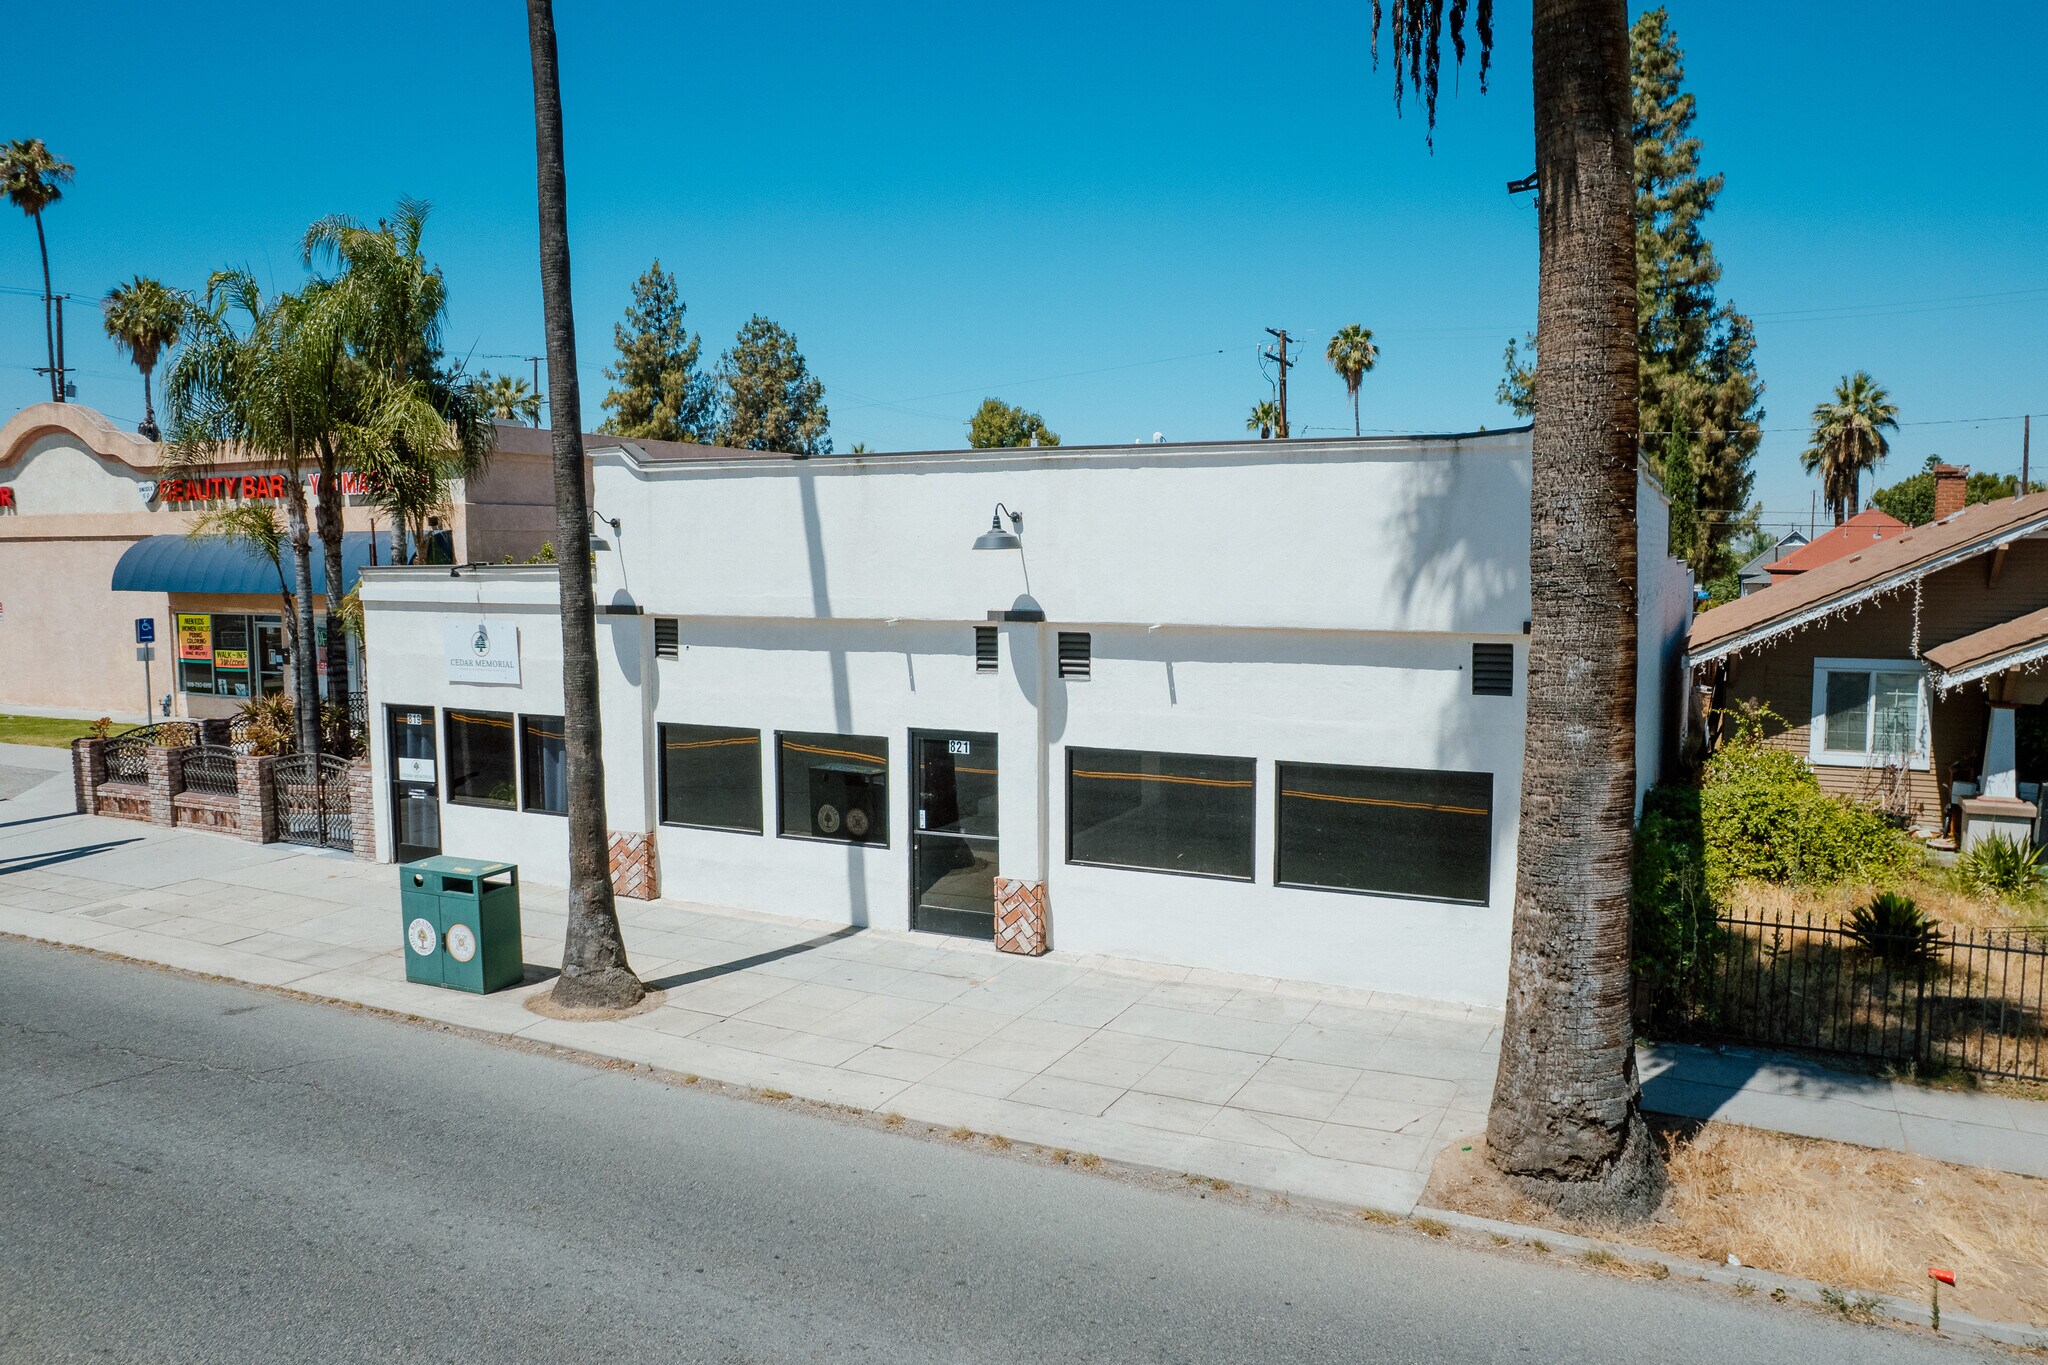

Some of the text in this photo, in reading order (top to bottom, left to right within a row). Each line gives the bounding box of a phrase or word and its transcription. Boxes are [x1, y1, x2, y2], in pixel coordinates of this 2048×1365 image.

[159, 477, 237, 502] BEAUTY
[242, 474, 285, 499] BAR
[450, 658, 515, 669] CEDAR MEMORIAL
[950, 740, 968, 753] 821
